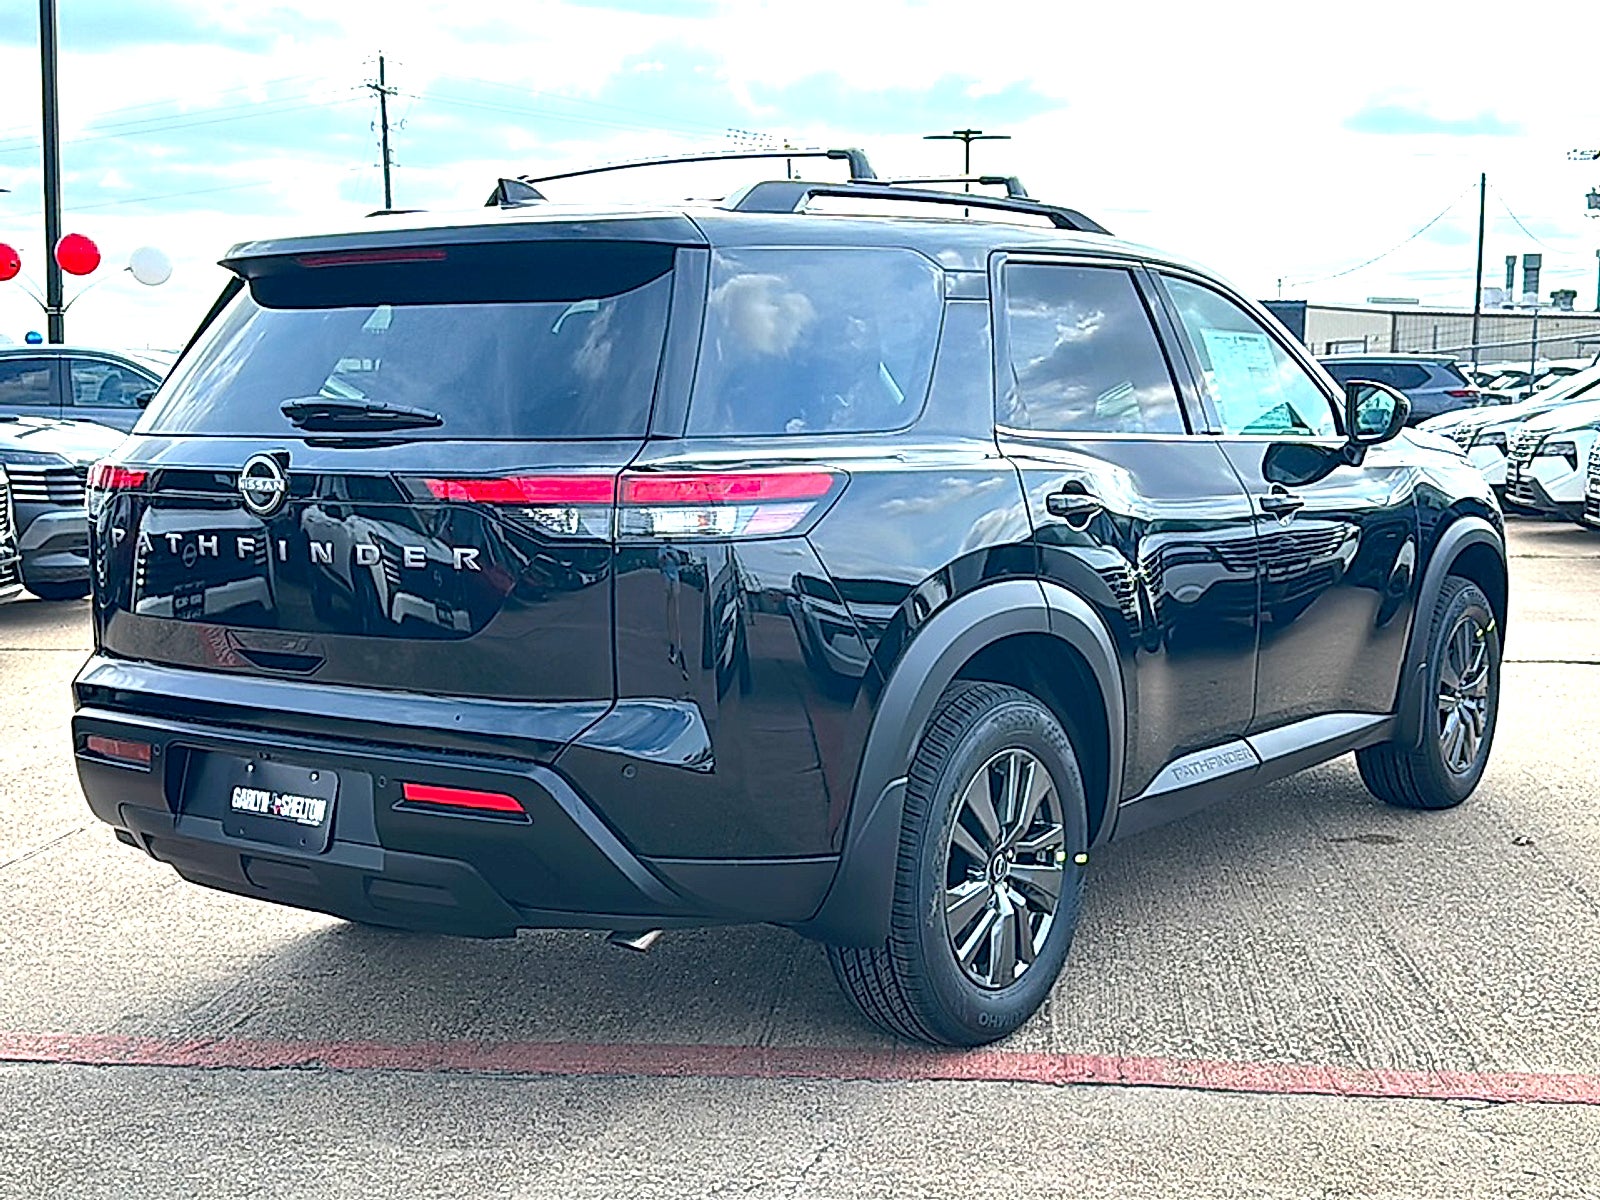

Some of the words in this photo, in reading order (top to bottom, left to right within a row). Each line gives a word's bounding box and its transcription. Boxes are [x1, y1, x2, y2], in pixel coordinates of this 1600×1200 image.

[111, 527, 482, 571] PATHFINDER
[1172, 747, 1253, 781] PATHFINDER
[280, 795, 326, 821] SHELTON
